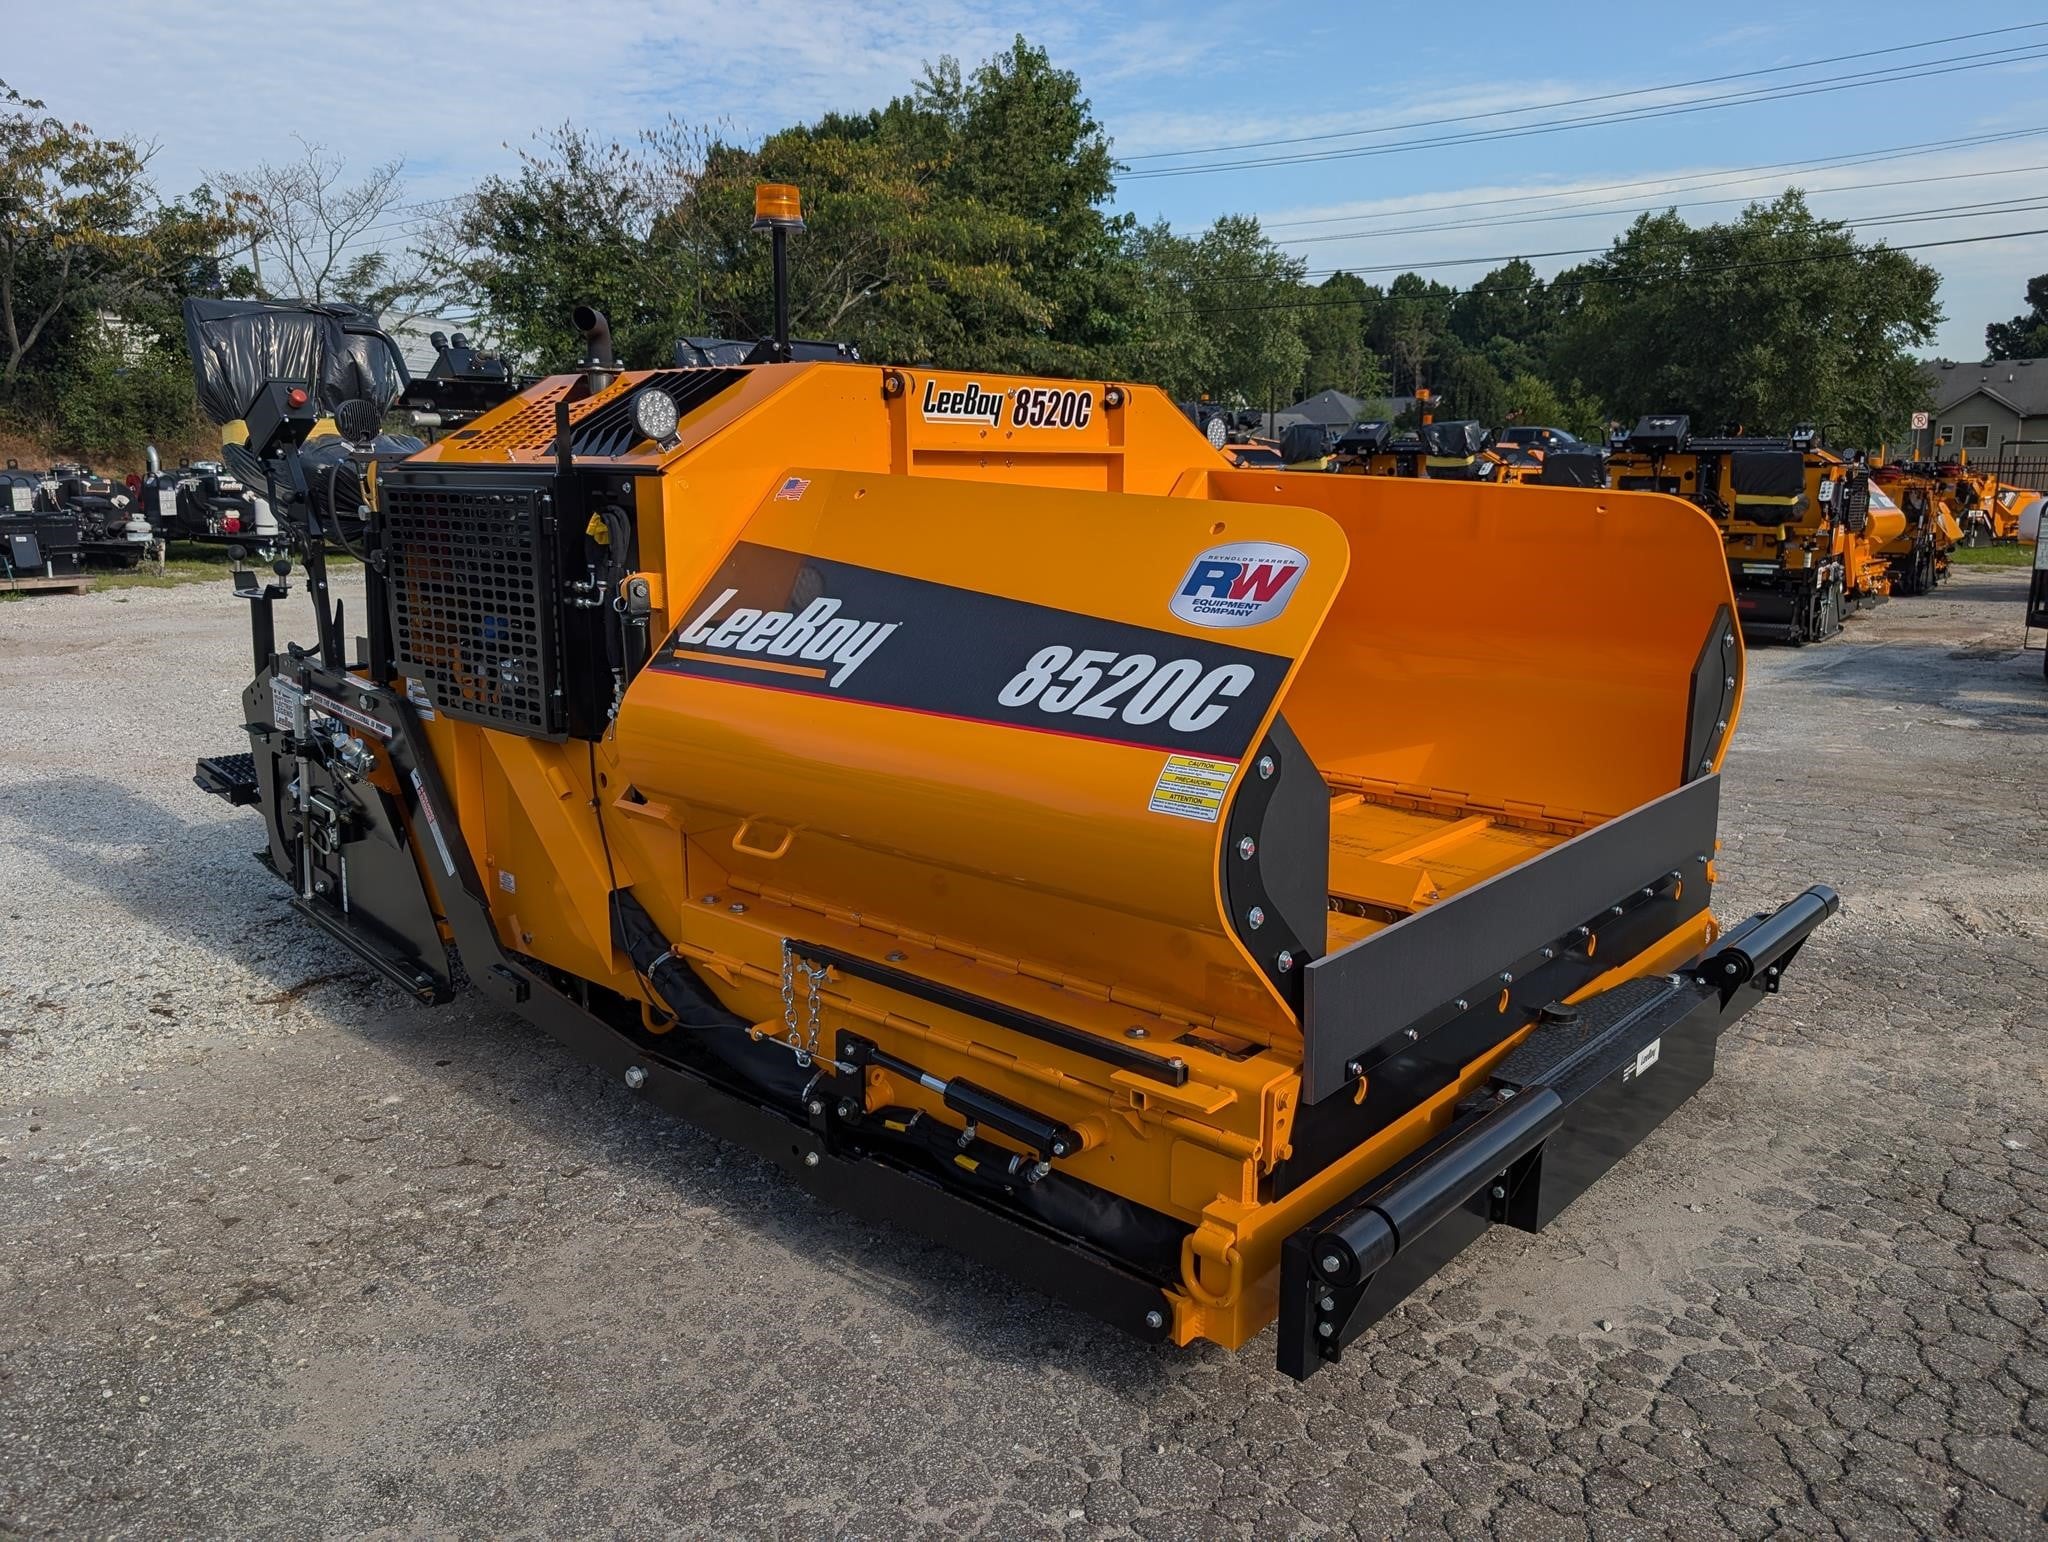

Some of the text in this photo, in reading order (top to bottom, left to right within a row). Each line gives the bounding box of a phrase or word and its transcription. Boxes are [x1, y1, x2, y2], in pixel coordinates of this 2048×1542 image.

[923, 381, 1092, 428] LeeBoy 8520C
[1207, 555, 1295, 565] REYNOLDS-WARREN
[1181, 561, 1300, 602] RW
[1192, 598, 1262, 610] EQUIPMENT
[1193, 606, 1253, 617] COMPANY
[678, 588, 900, 688] LeeBoy
[998, 645, 1256, 732] 8520C
[1188, 760, 1215, 769] CAUTION
[1169, 794, 1203, 804] ATTENTION
